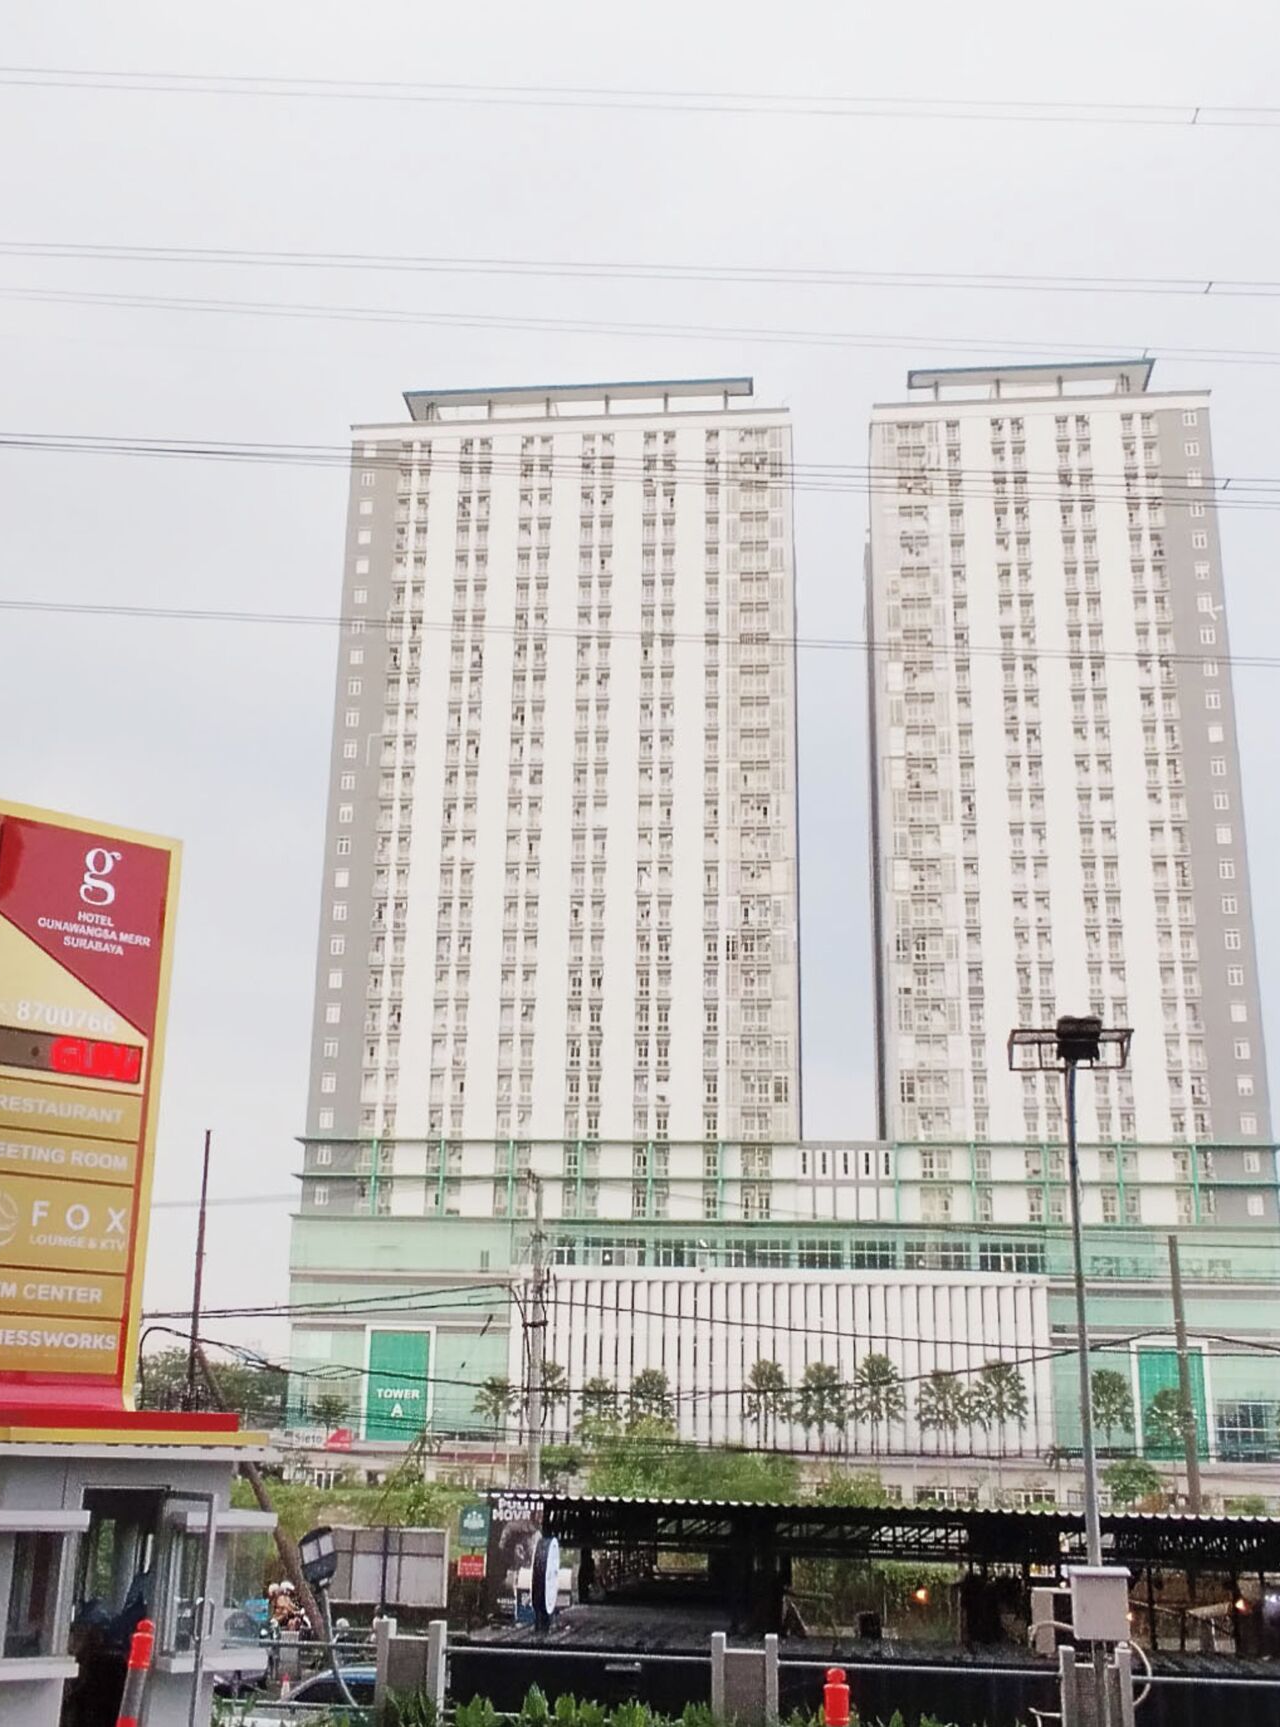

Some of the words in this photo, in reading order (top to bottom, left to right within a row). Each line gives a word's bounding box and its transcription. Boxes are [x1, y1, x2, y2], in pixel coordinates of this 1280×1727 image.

[77, 911, 114, 927] HOTEL
[63, 935, 124, 956] SURABAYA
[118, 931, 151, 947] MERR
[70, 1150, 129, 1172] ROOM
[30, 1200, 127, 1234] FOX
[29, 1234, 83, 1248] LOUNGE
[99, 1238, 126, 1252] KTV
[22, 1283, 102, 1304] CENTER
[376, 1388, 420, 1399] TOWER
[390, 1402, 404, 1418] A
